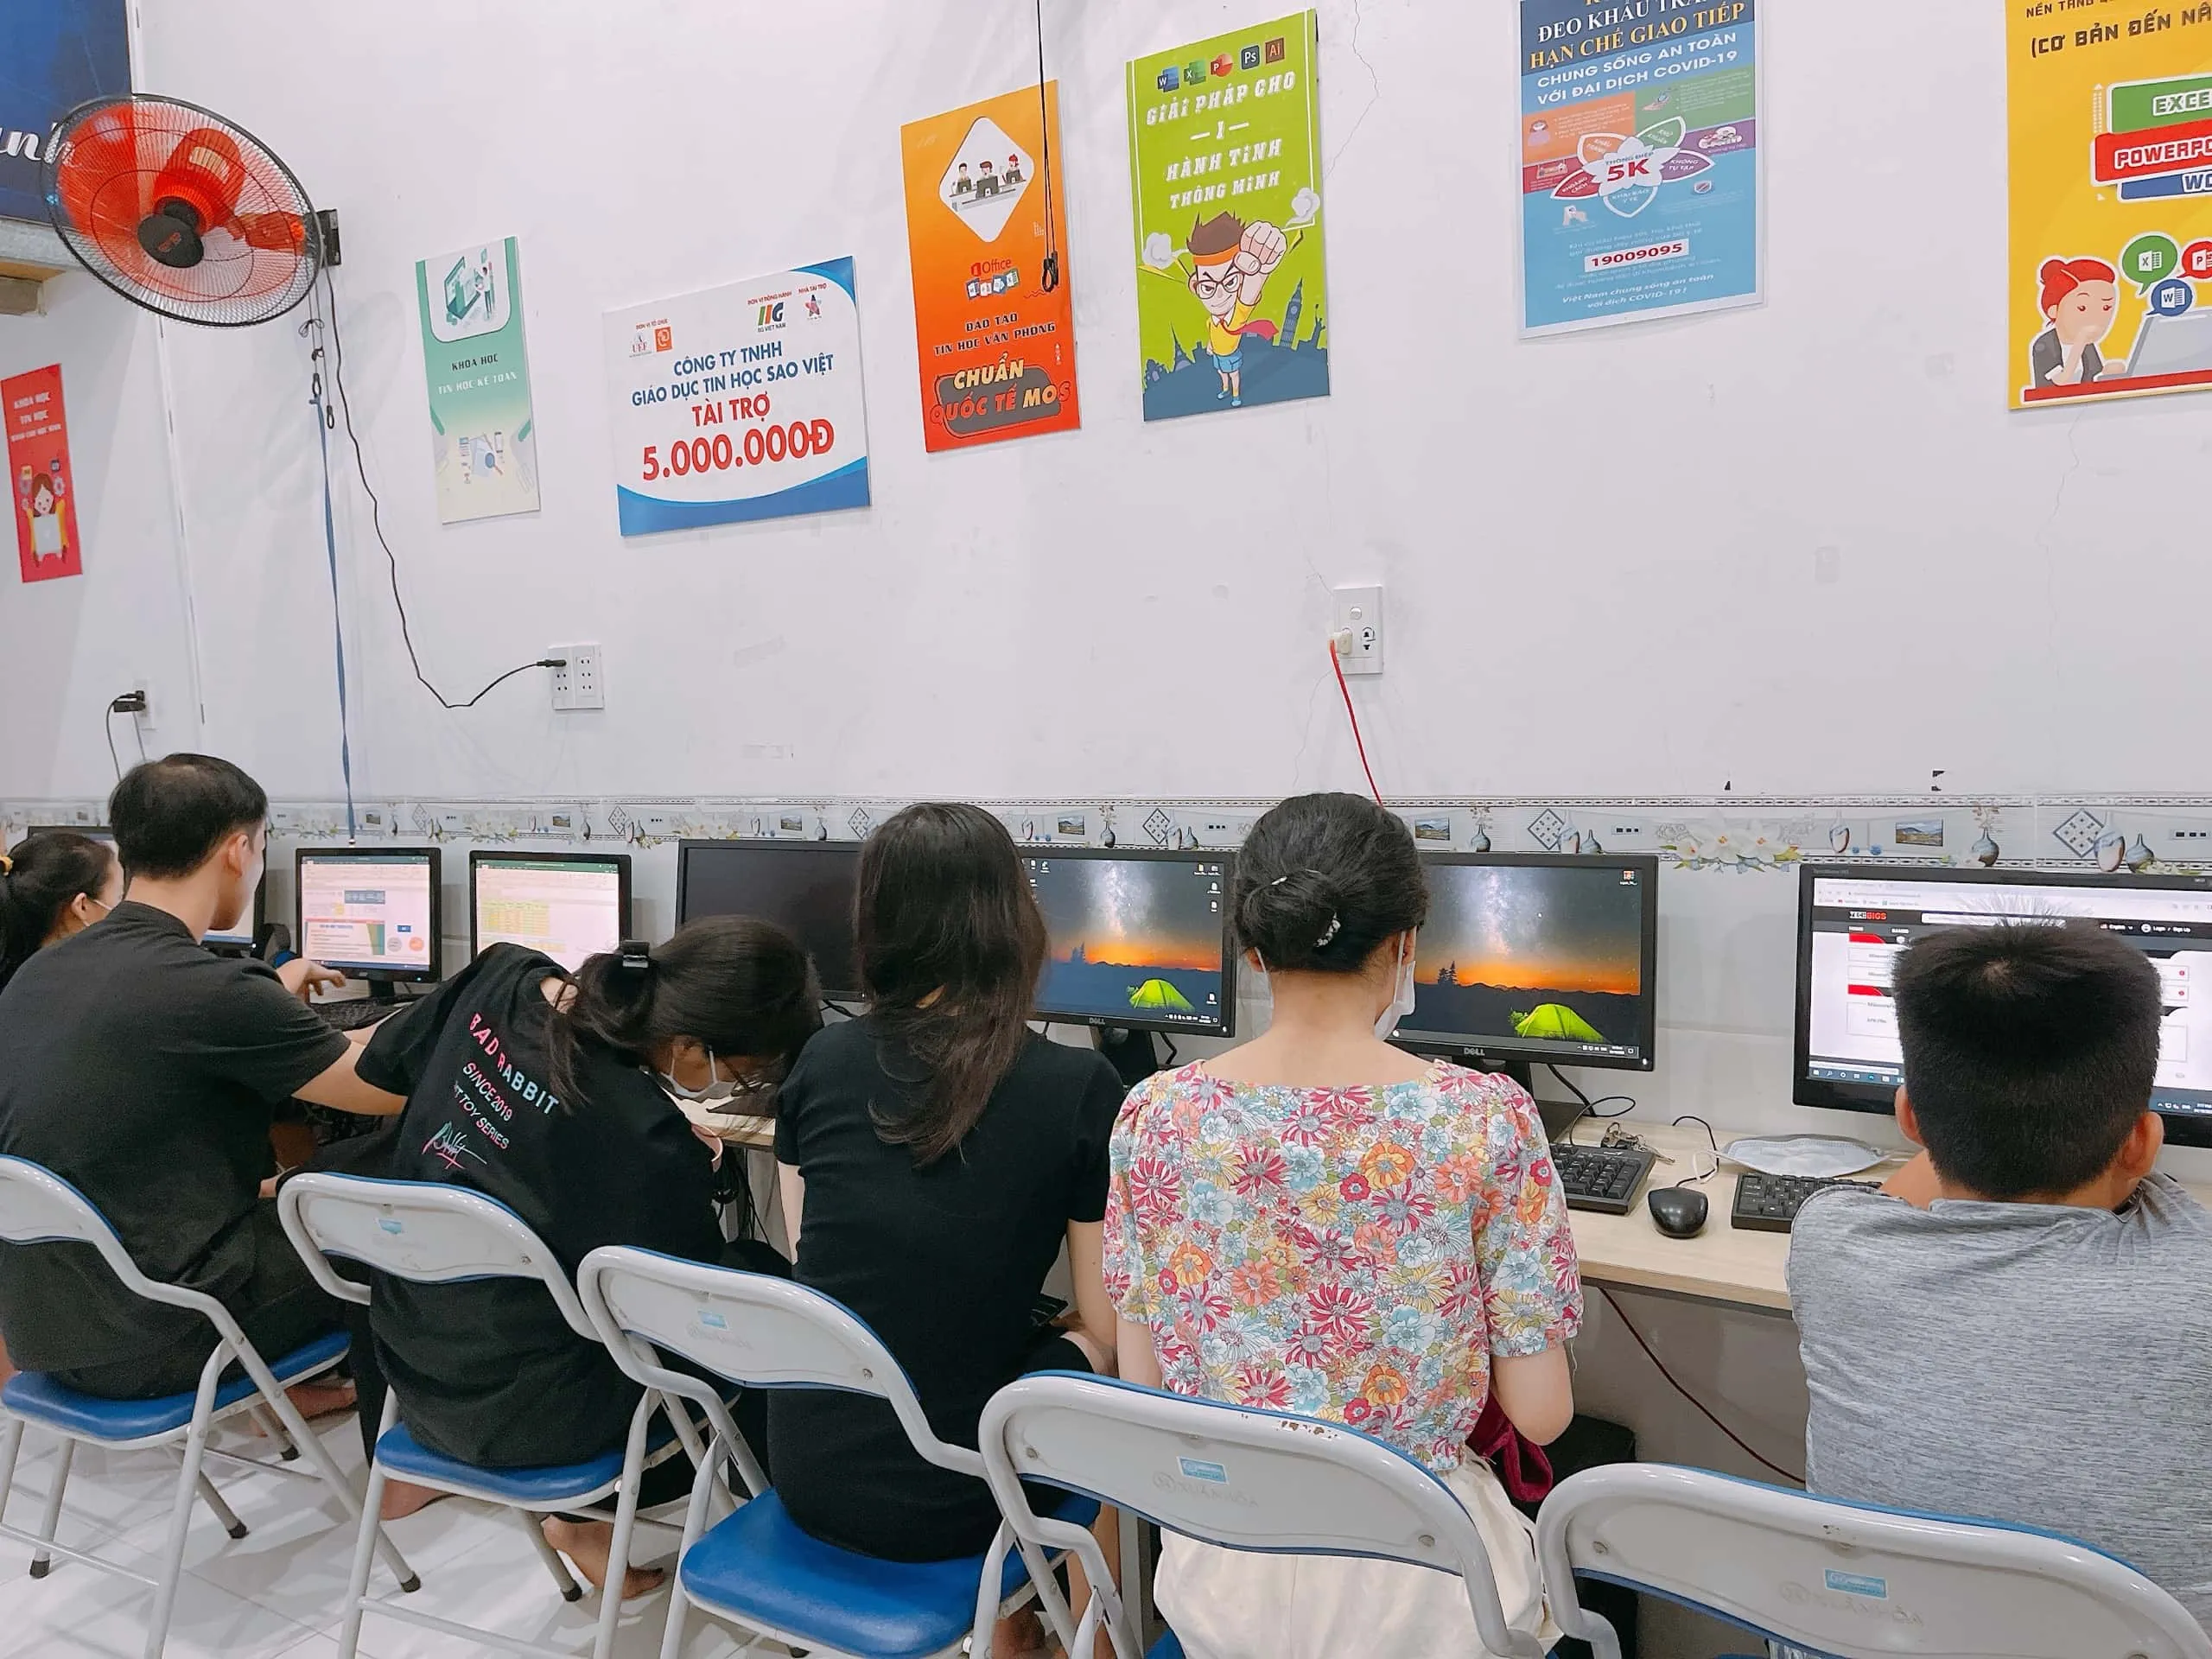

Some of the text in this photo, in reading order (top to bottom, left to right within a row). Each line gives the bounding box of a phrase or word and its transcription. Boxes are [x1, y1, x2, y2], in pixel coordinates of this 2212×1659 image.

[1529, 43, 1574, 69] HẠN
[1630, 16, 1688, 45] GIAO
[1694, 2, 1745, 29] TIẾP
[1538, 17, 1581, 43] ĐEO
[2075, 23, 2118, 47] BẢN
[2128, 9, 2171, 36] ĐẾN
[1244, 52, 1256, 65] Ps
[1269, 43, 1281, 56] Ai
[1537, 32, 1737, 88] CHUNG SỐNG AN TOÀN
[1255, 71, 1296, 98] CHO
[1538, 50, 1738, 105] VỚI ĐẠI DỊCH COVID-19
[1166, 152, 1222, 181] HÀNH
[1607, 158, 1650, 181] 5K
[1170, 182, 1226, 210] THÔNG
[982, 257, 1012, 274] Office
[1592, 243, 1682, 267] 19009095
[673, 340, 782, 377] CÔNG TY TNHH
[934, 344, 952, 356] TIN
[632, 352, 834, 406] GIÁO DỤC TIN HỌC SAO VIỆT
[953, 352, 1025, 390] CHUẨN
[691, 391, 771, 428] TÀI TRỢ
[930, 380, 1071, 425] QUỐC TẾ MOS
[643, 418, 835, 481] 5.000.000Đ
[469, 1013, 559, 1115] BAD RABBIT
[1464, 1047, 1485, 1056] DELL
[459, 1093, 481, 1116] TOY
[475, 1117, 510, 1149] SERIES
